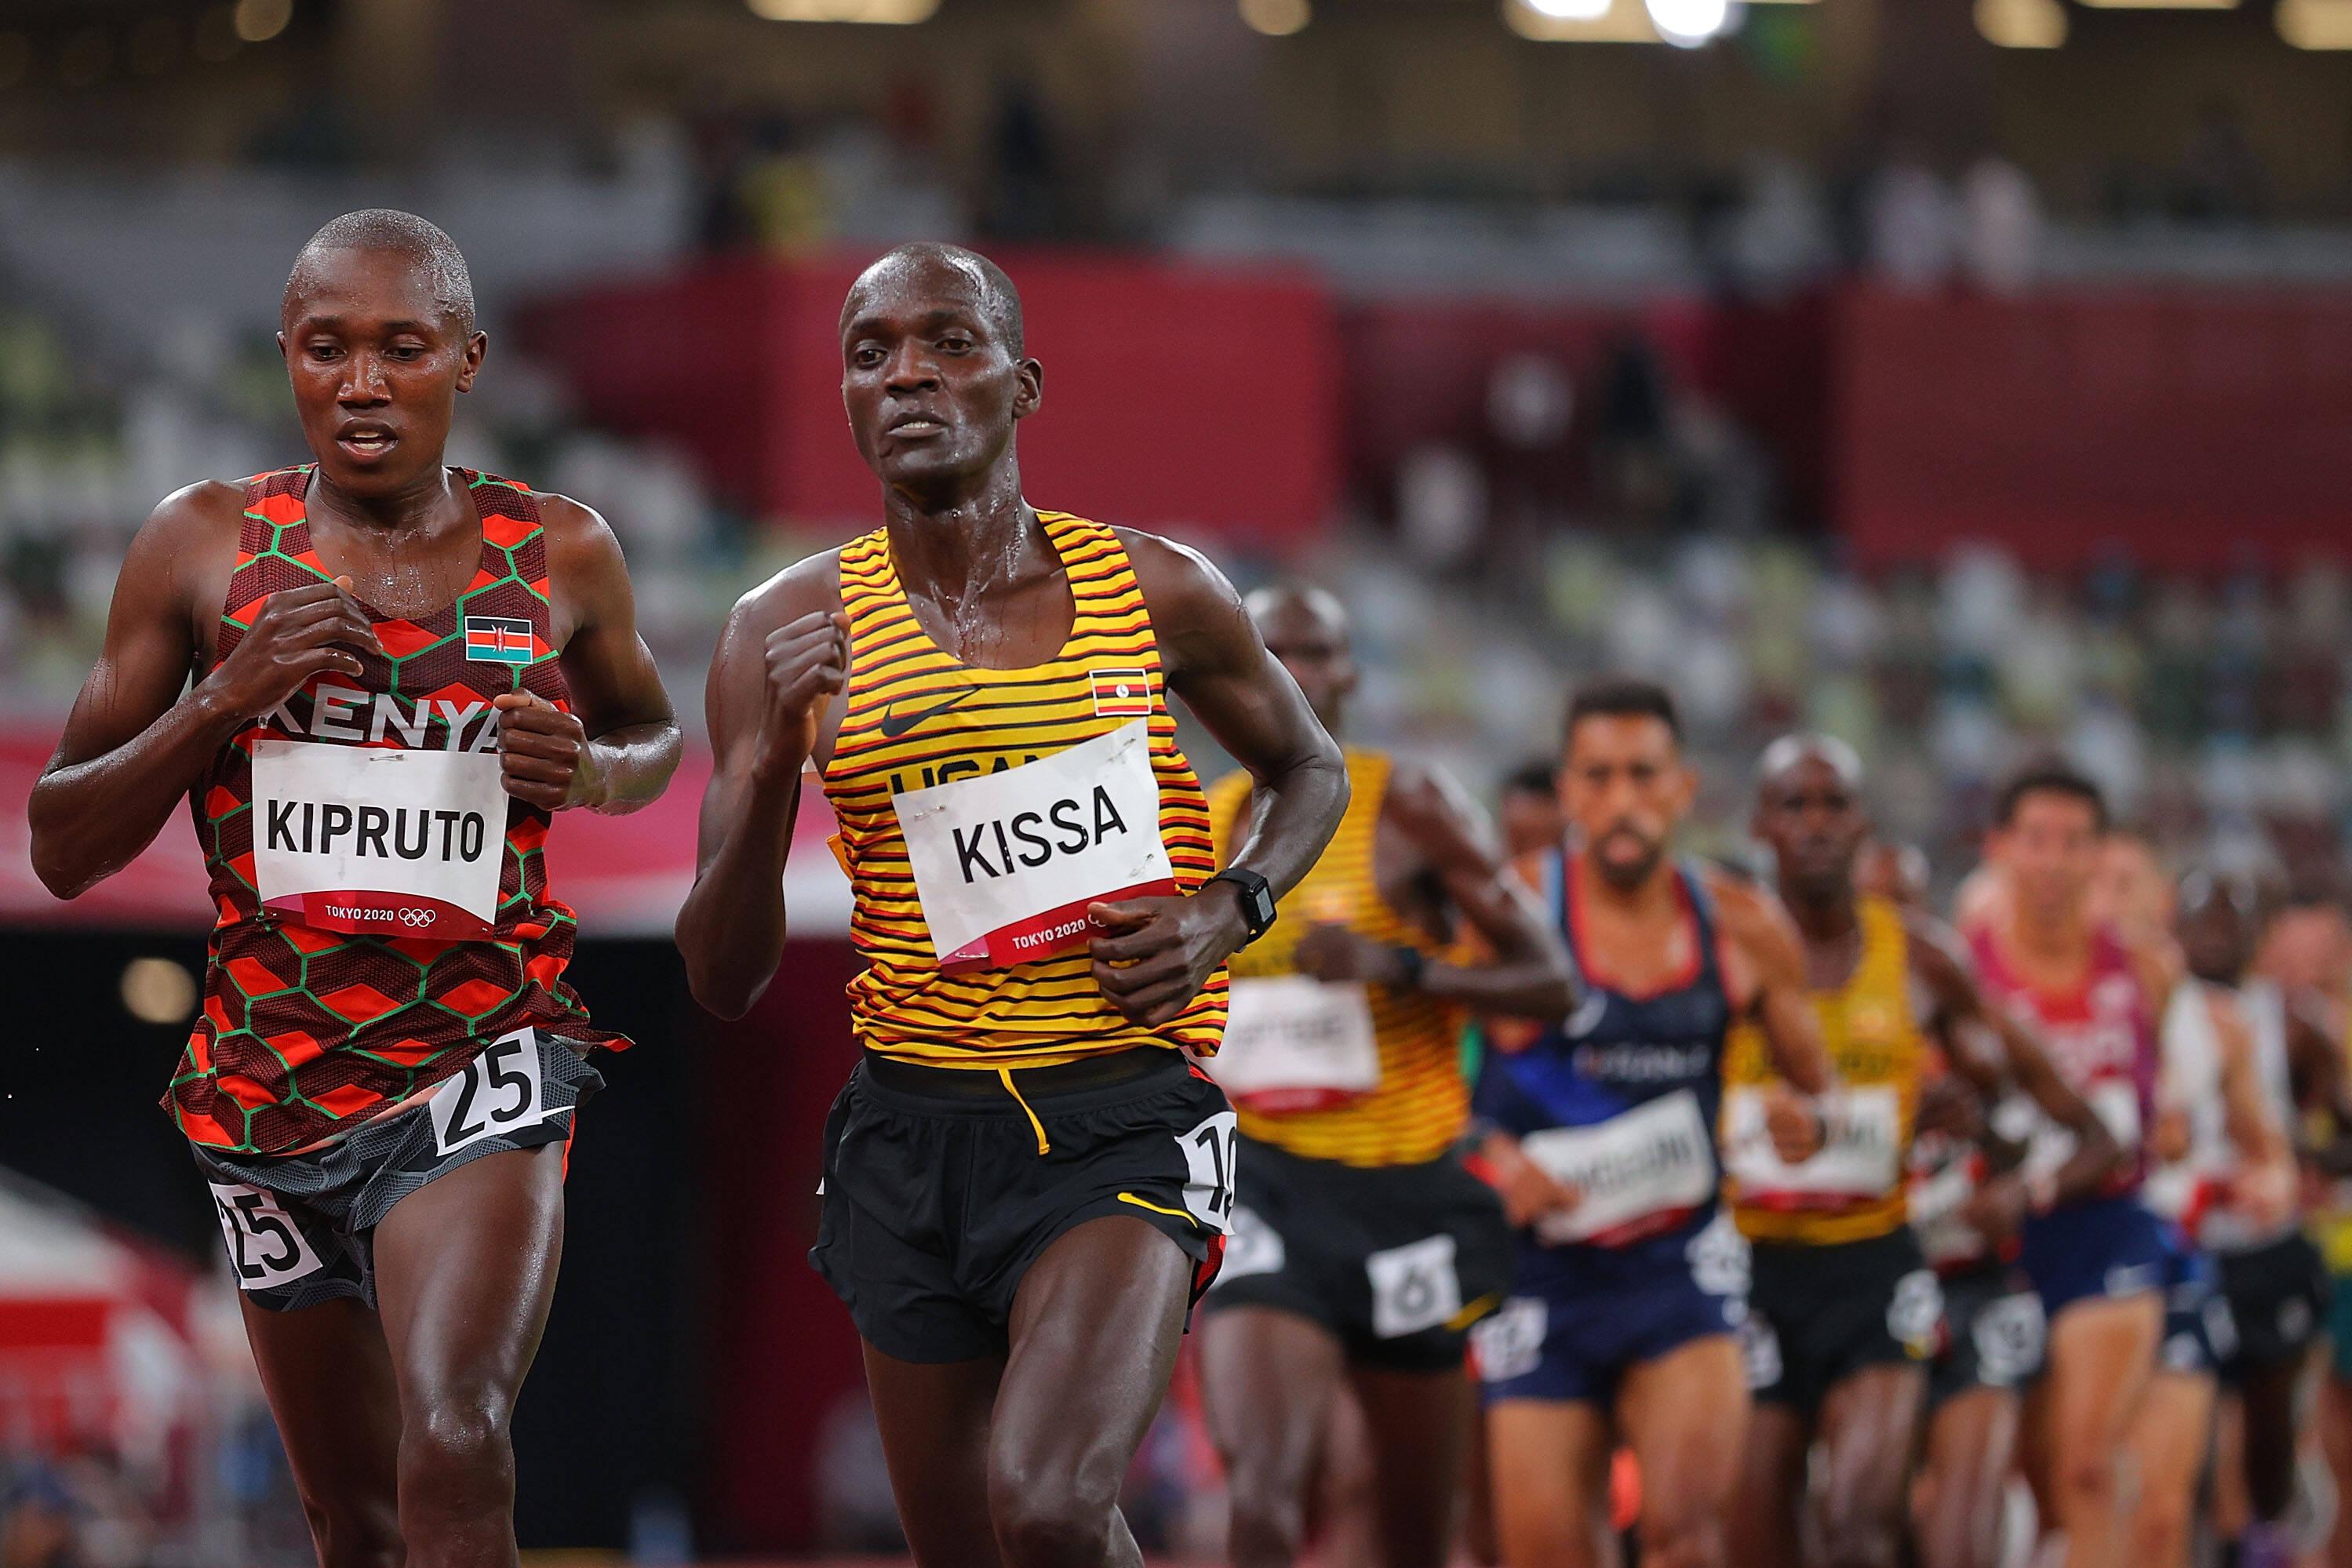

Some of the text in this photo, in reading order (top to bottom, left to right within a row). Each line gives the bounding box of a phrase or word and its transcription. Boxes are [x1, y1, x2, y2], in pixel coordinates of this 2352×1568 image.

[267, 799, 485, 864] KIPRUTO
[952, 785, 1127, 883] KISSA
[325, 905, 394, 921] TOKYO 2020
[1012, 919, 1086, 950] TOKYO 2020
[443, 1038, 532, 1147] 25
[216, 1192, 301, 1279] 25
